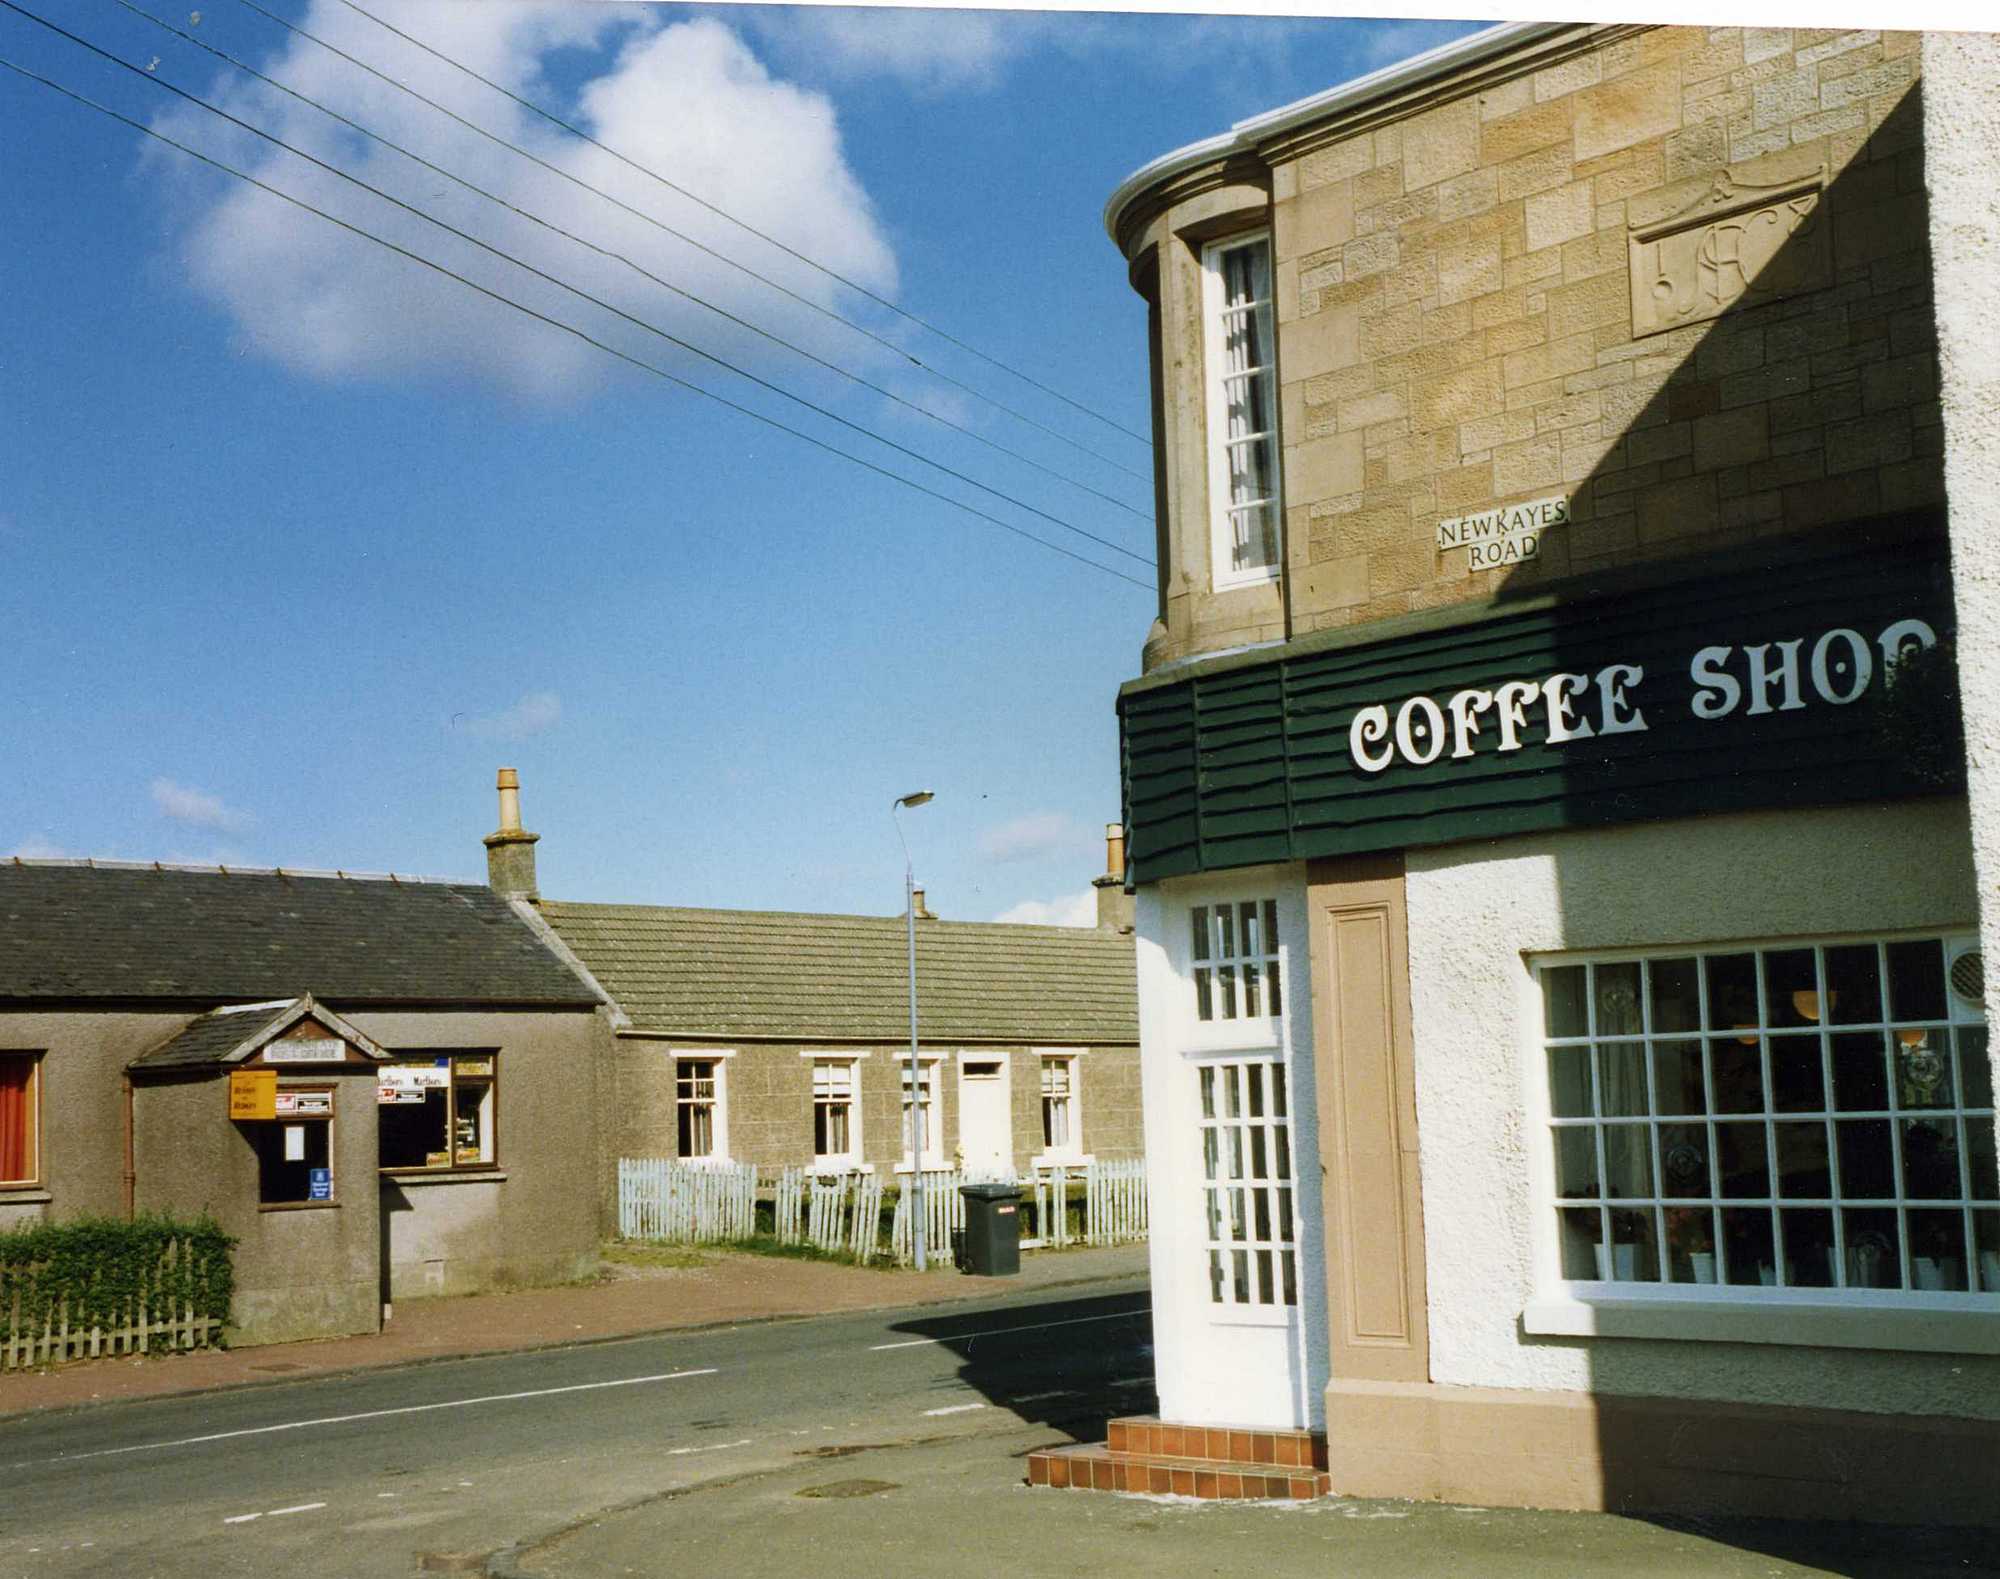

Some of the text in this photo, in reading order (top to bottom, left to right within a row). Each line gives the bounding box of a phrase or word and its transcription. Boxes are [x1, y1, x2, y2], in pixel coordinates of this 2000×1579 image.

[1440, 500, 1567, 545] NEWKAYES
[1470, 535, 1538, 567] ROAD
[1348, 663, 1650, 773] COFFEE
